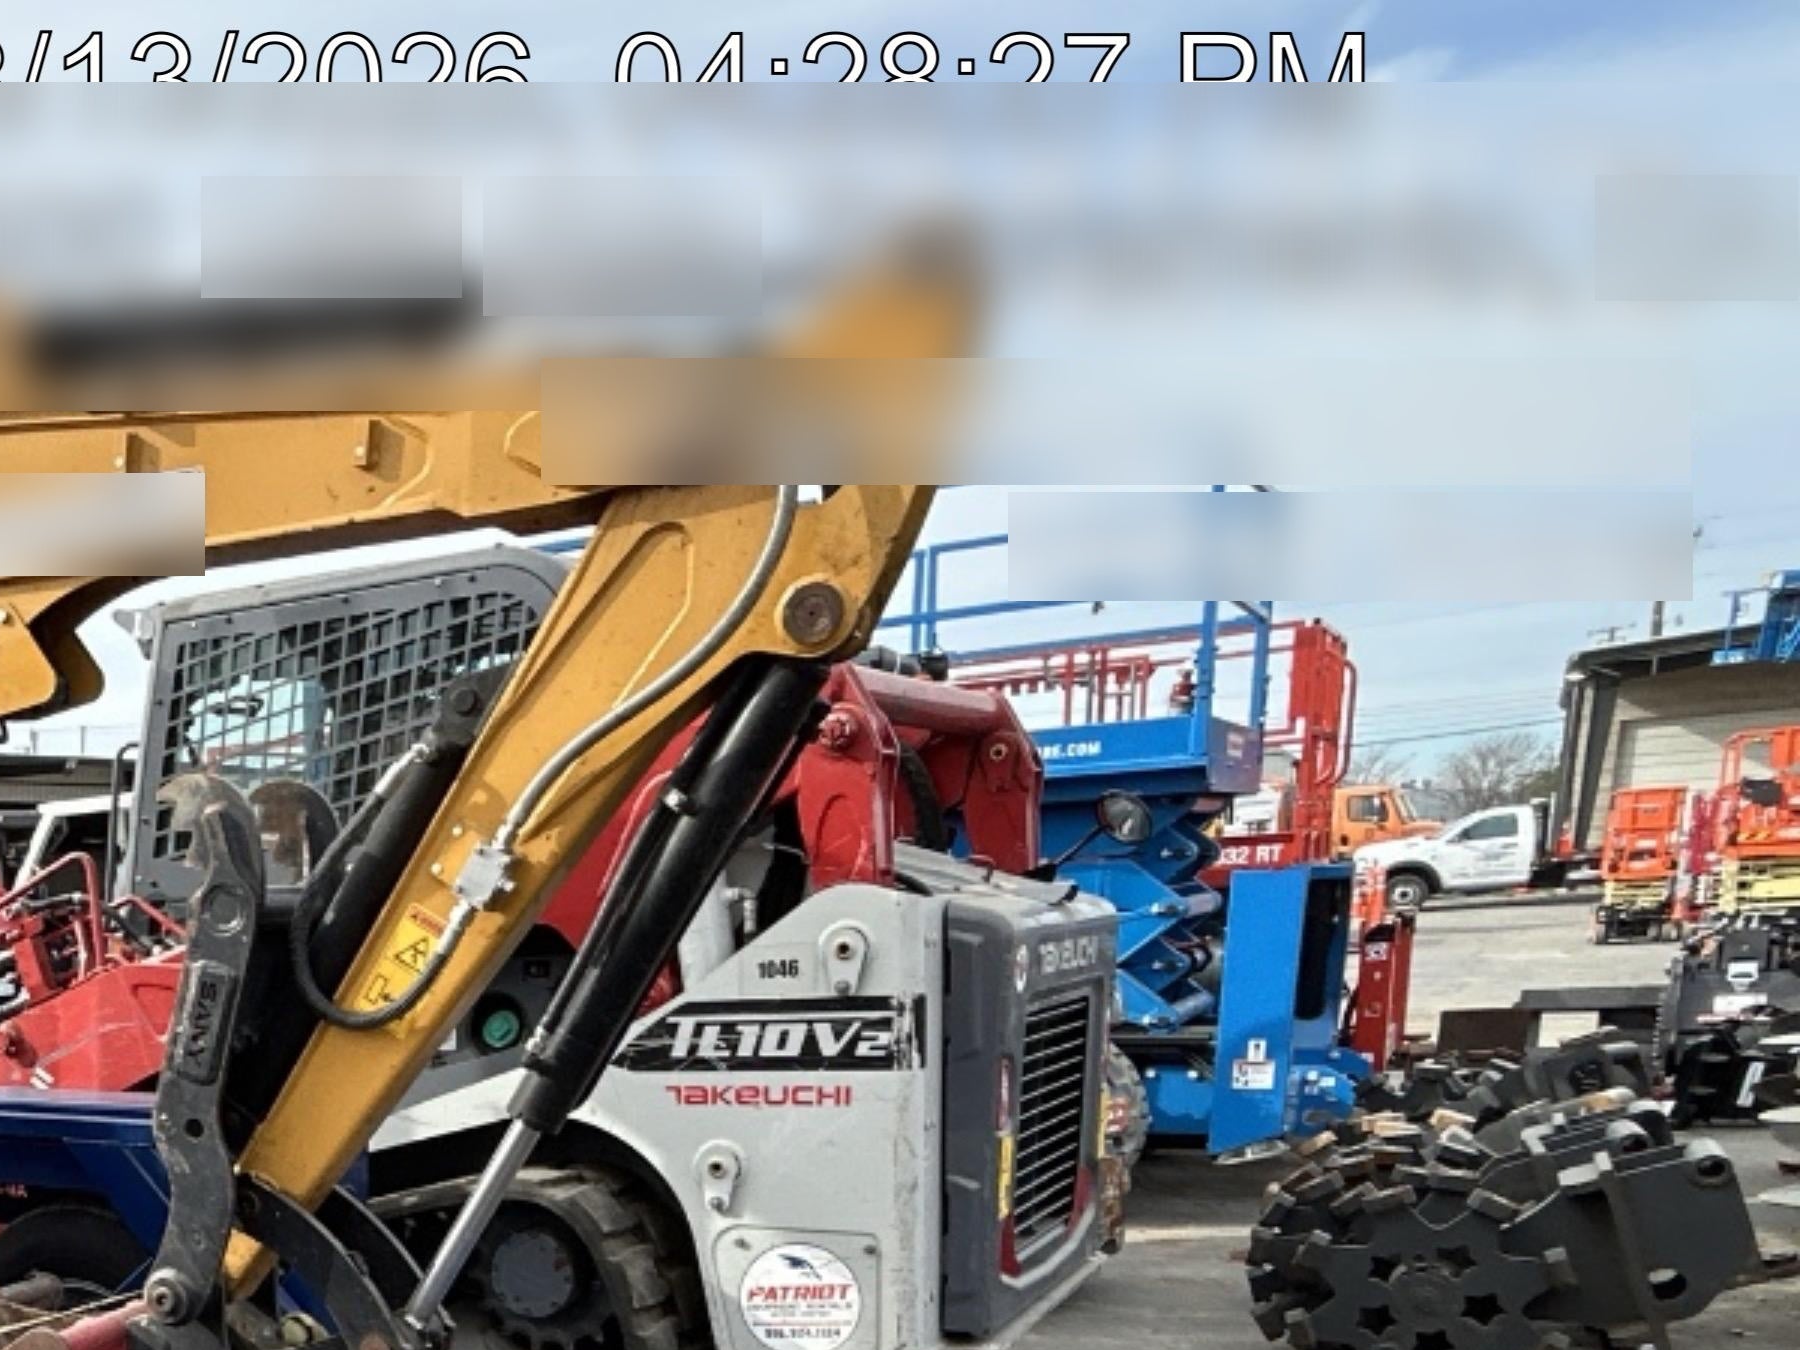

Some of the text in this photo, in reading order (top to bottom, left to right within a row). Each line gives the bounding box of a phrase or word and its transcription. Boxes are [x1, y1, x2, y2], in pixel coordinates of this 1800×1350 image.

[1256, 842, 1286, 864] RT
[757, 959, 800, 980] 1046
[746, 1283, 853, 1303] PATRIOT
